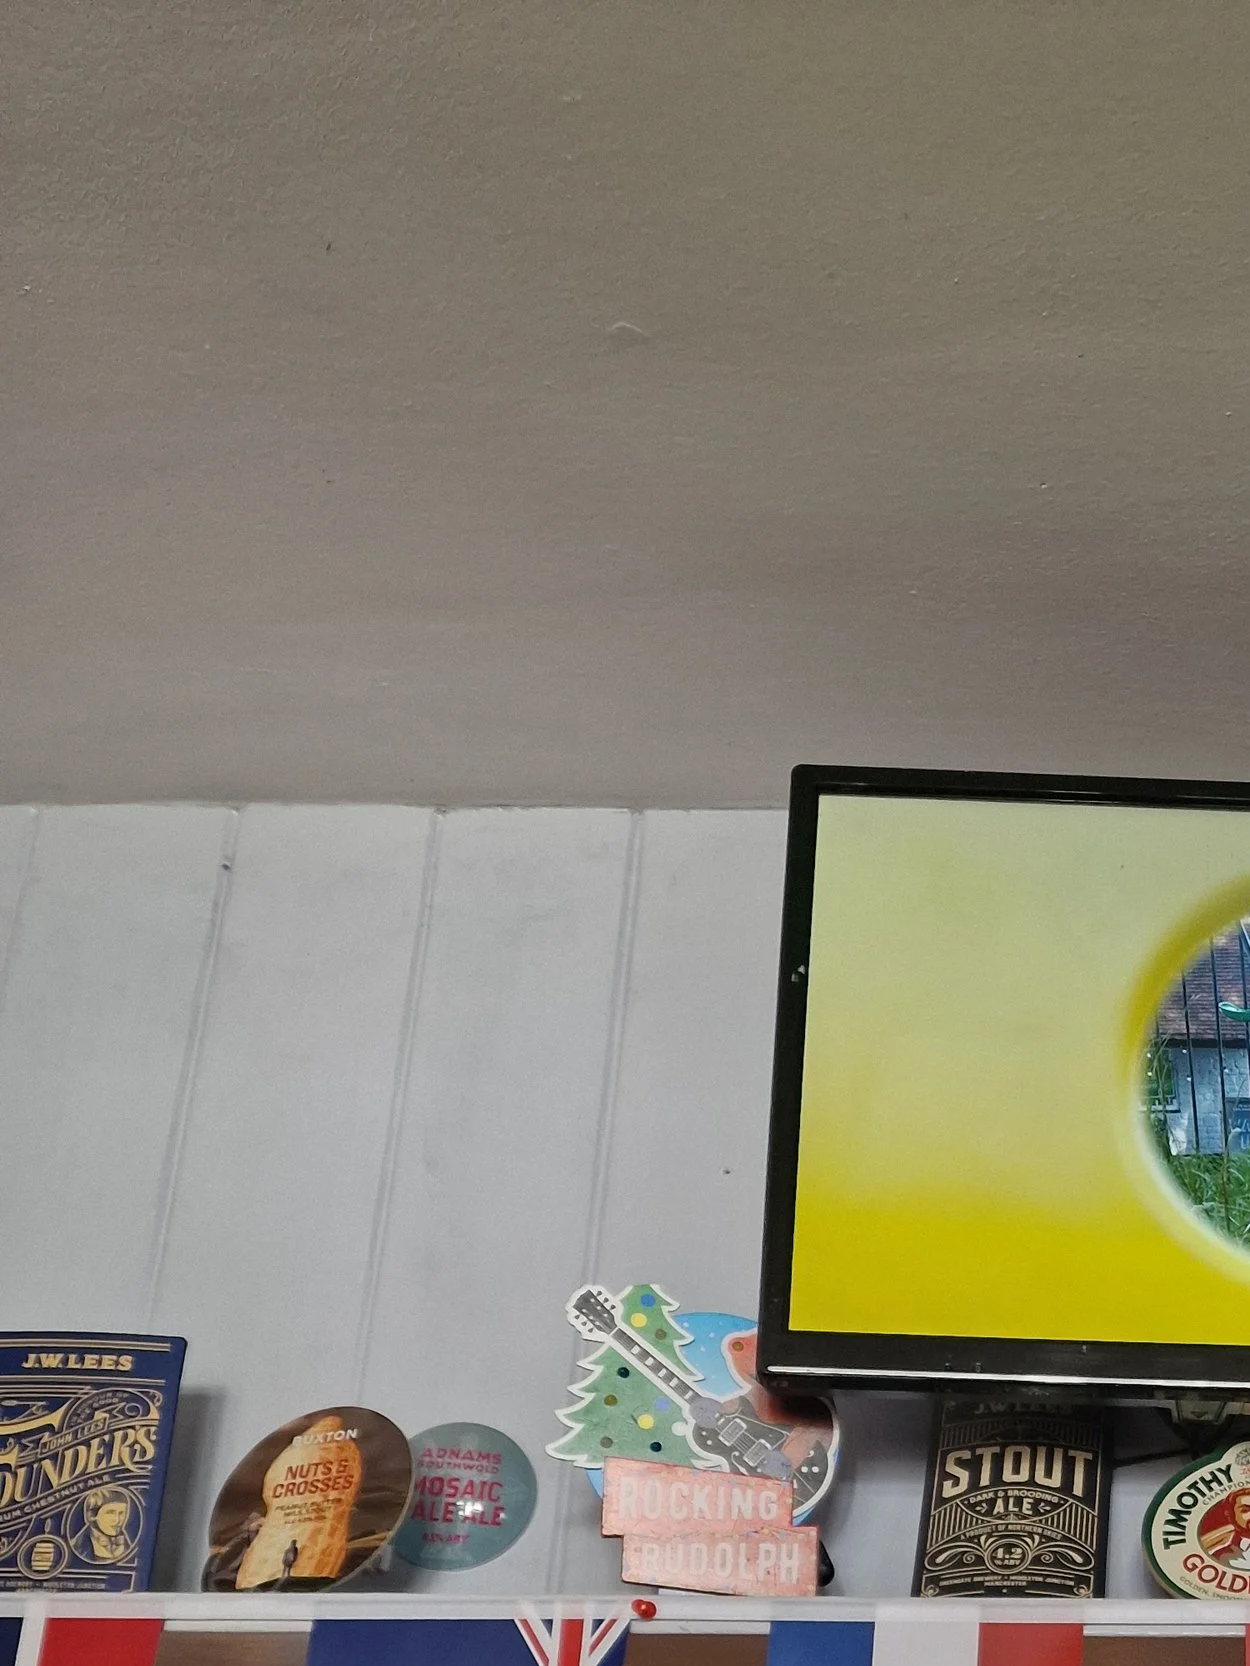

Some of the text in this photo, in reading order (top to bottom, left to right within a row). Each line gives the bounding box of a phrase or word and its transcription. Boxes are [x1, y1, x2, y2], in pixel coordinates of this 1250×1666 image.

[66, 1353, 134, 1371] LEES
[420, 1447, 502, 1465] ADNAMS
[285, 1461, 333, 1480] NUTS
[417, 1460, 500, 1475] SOUTHWOLD
[942, 1445, 1093, 1499] STOUT
[87, 1474, 111, 1487] ALE
[272, 1475, 355, 1499] CROSSES
[620, 1476, 778, 1522] ROCKING
[969, 1492, 996, 1504] DARK
[1007, 1489, 1059, 1503] BROODING
[992, 1498, 1034, 1516] ALE
[1162, 1463, 1233, 1550] TIMOTHY
[966, 1525, 997, 1539] PRODUCT
[995, 1547, 1023, 1559] 4.2
[641, 1542, 800, 1585] RUDOLPH
